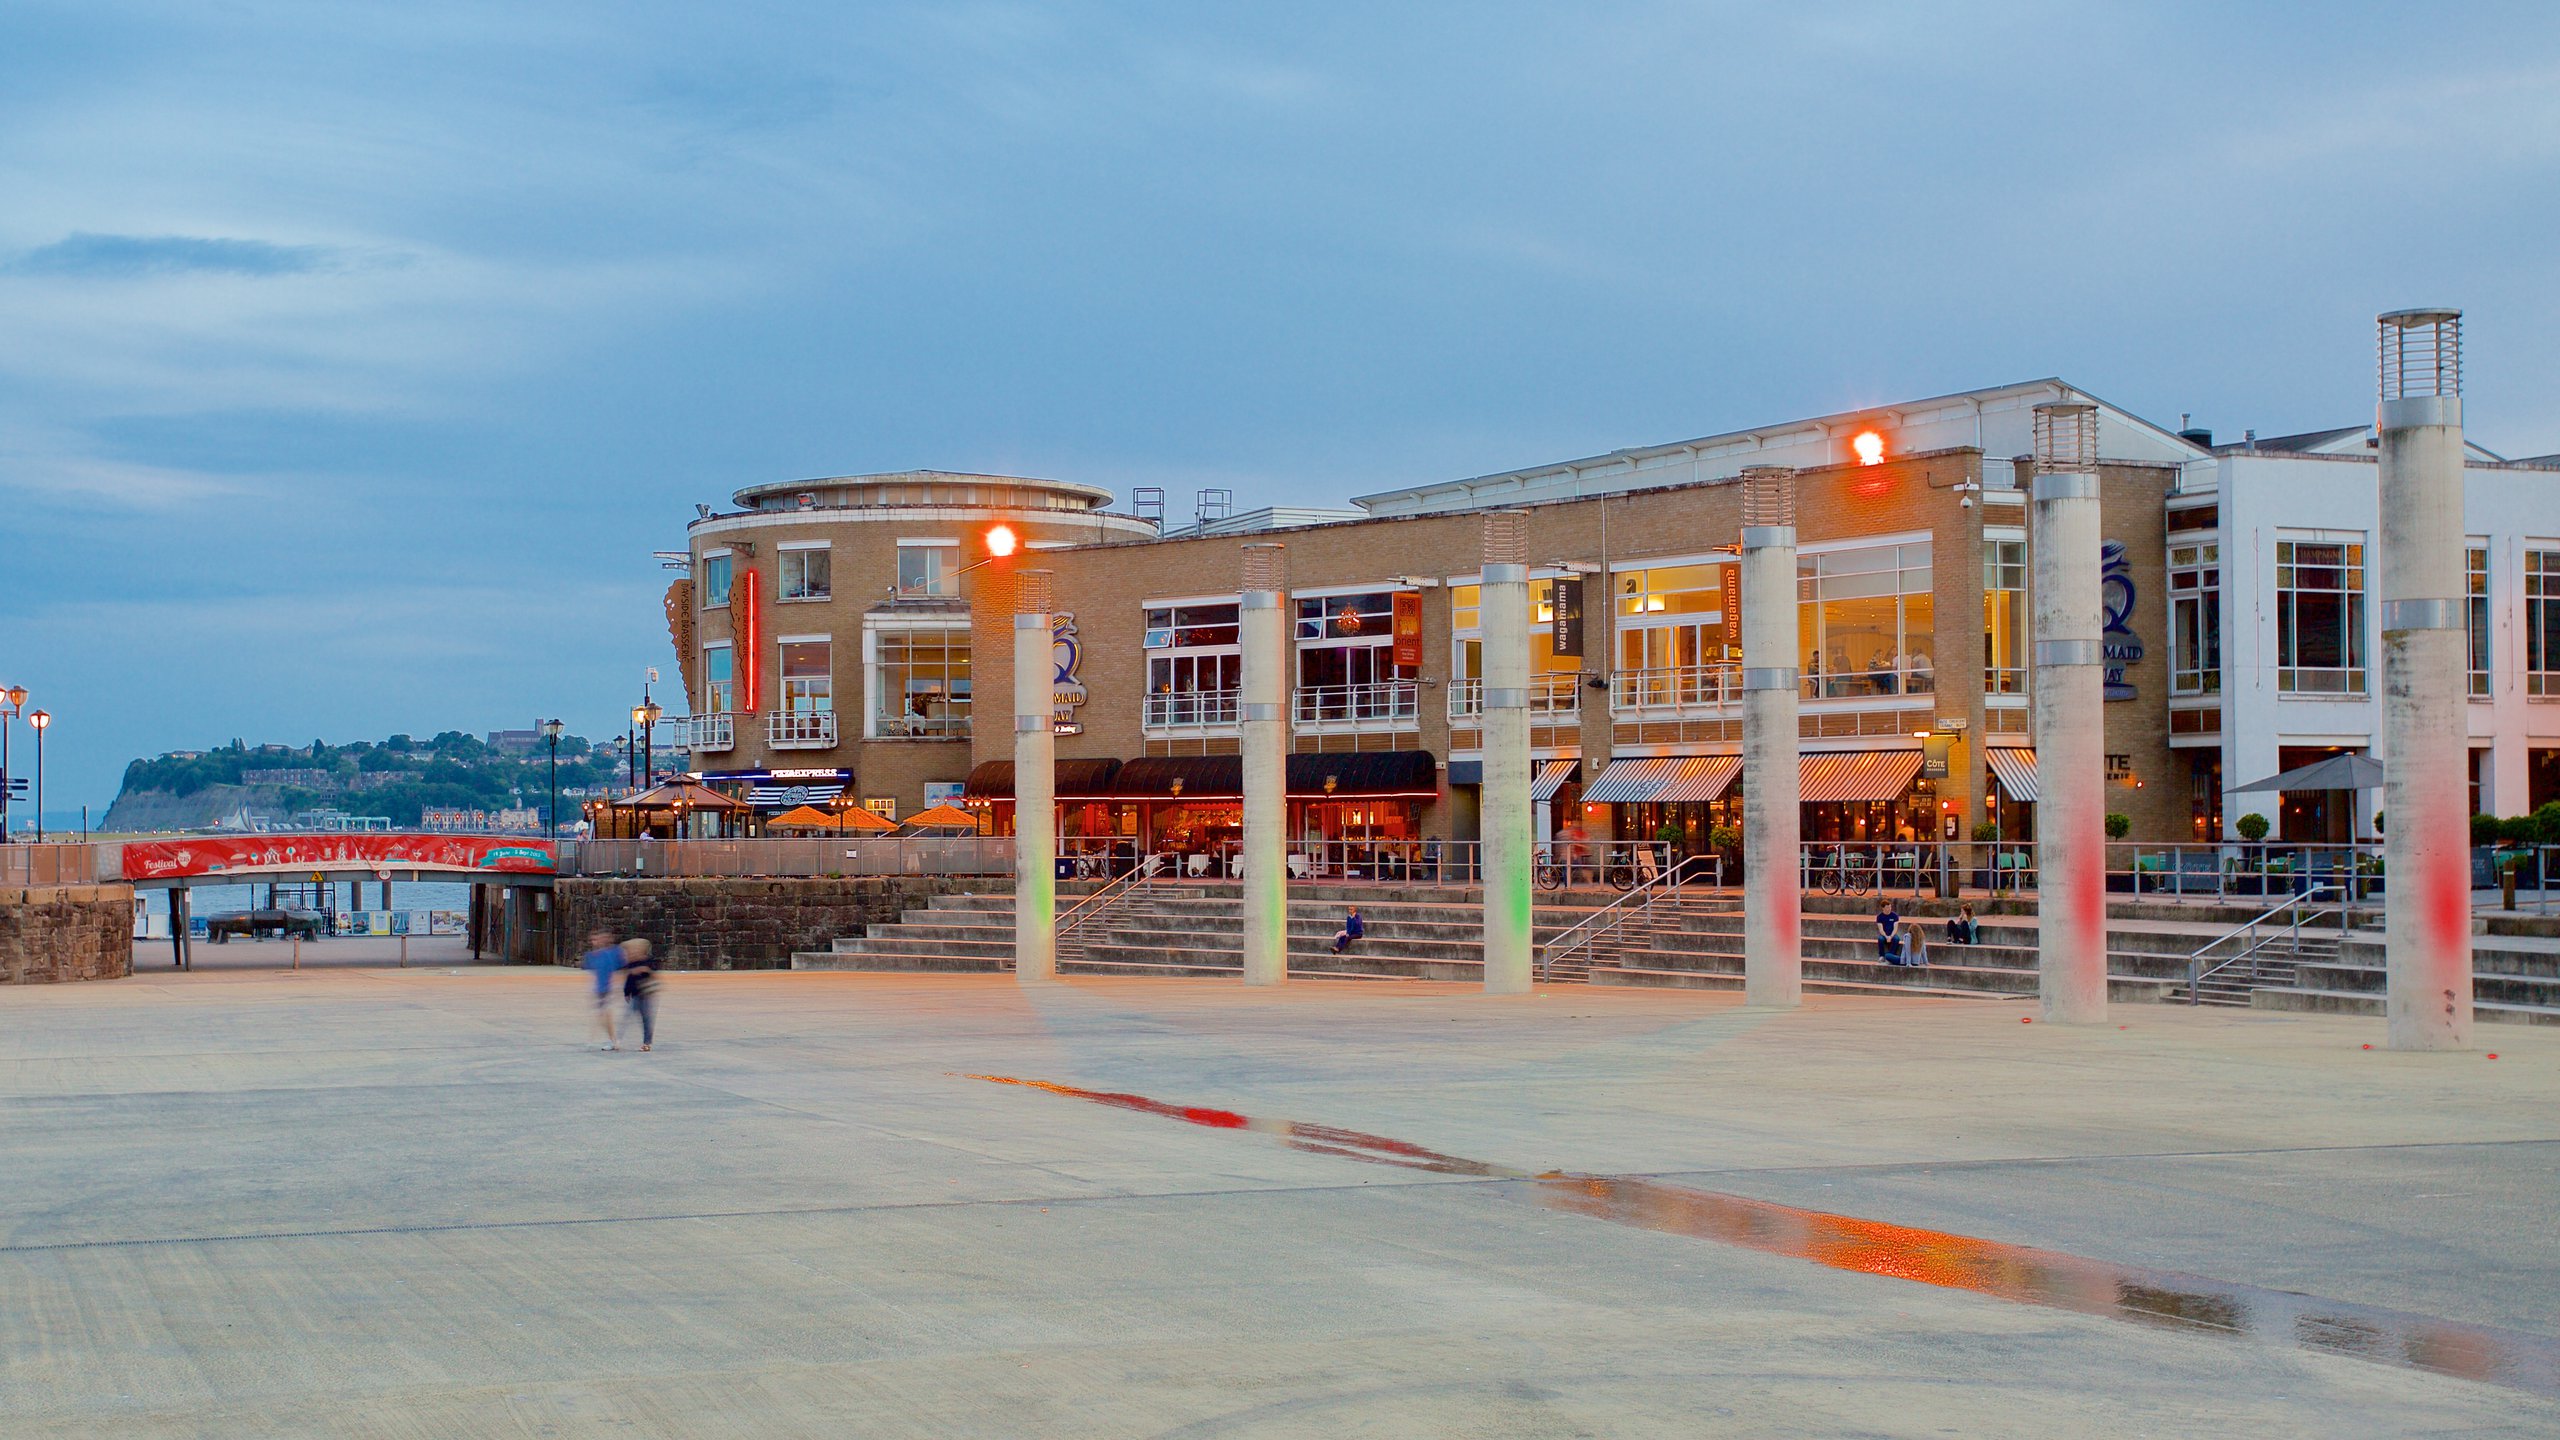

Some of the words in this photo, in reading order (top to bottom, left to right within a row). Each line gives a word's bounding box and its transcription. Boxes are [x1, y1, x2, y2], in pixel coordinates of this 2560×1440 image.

[1728, 569, 1738, 639] wagamama
[1559, 585, 1568, 650] wagamama
[1396, 637, 1420, 646] orient
[2104, 754, 2130, 770] TE
[144, 858, 178, 870] Festival
